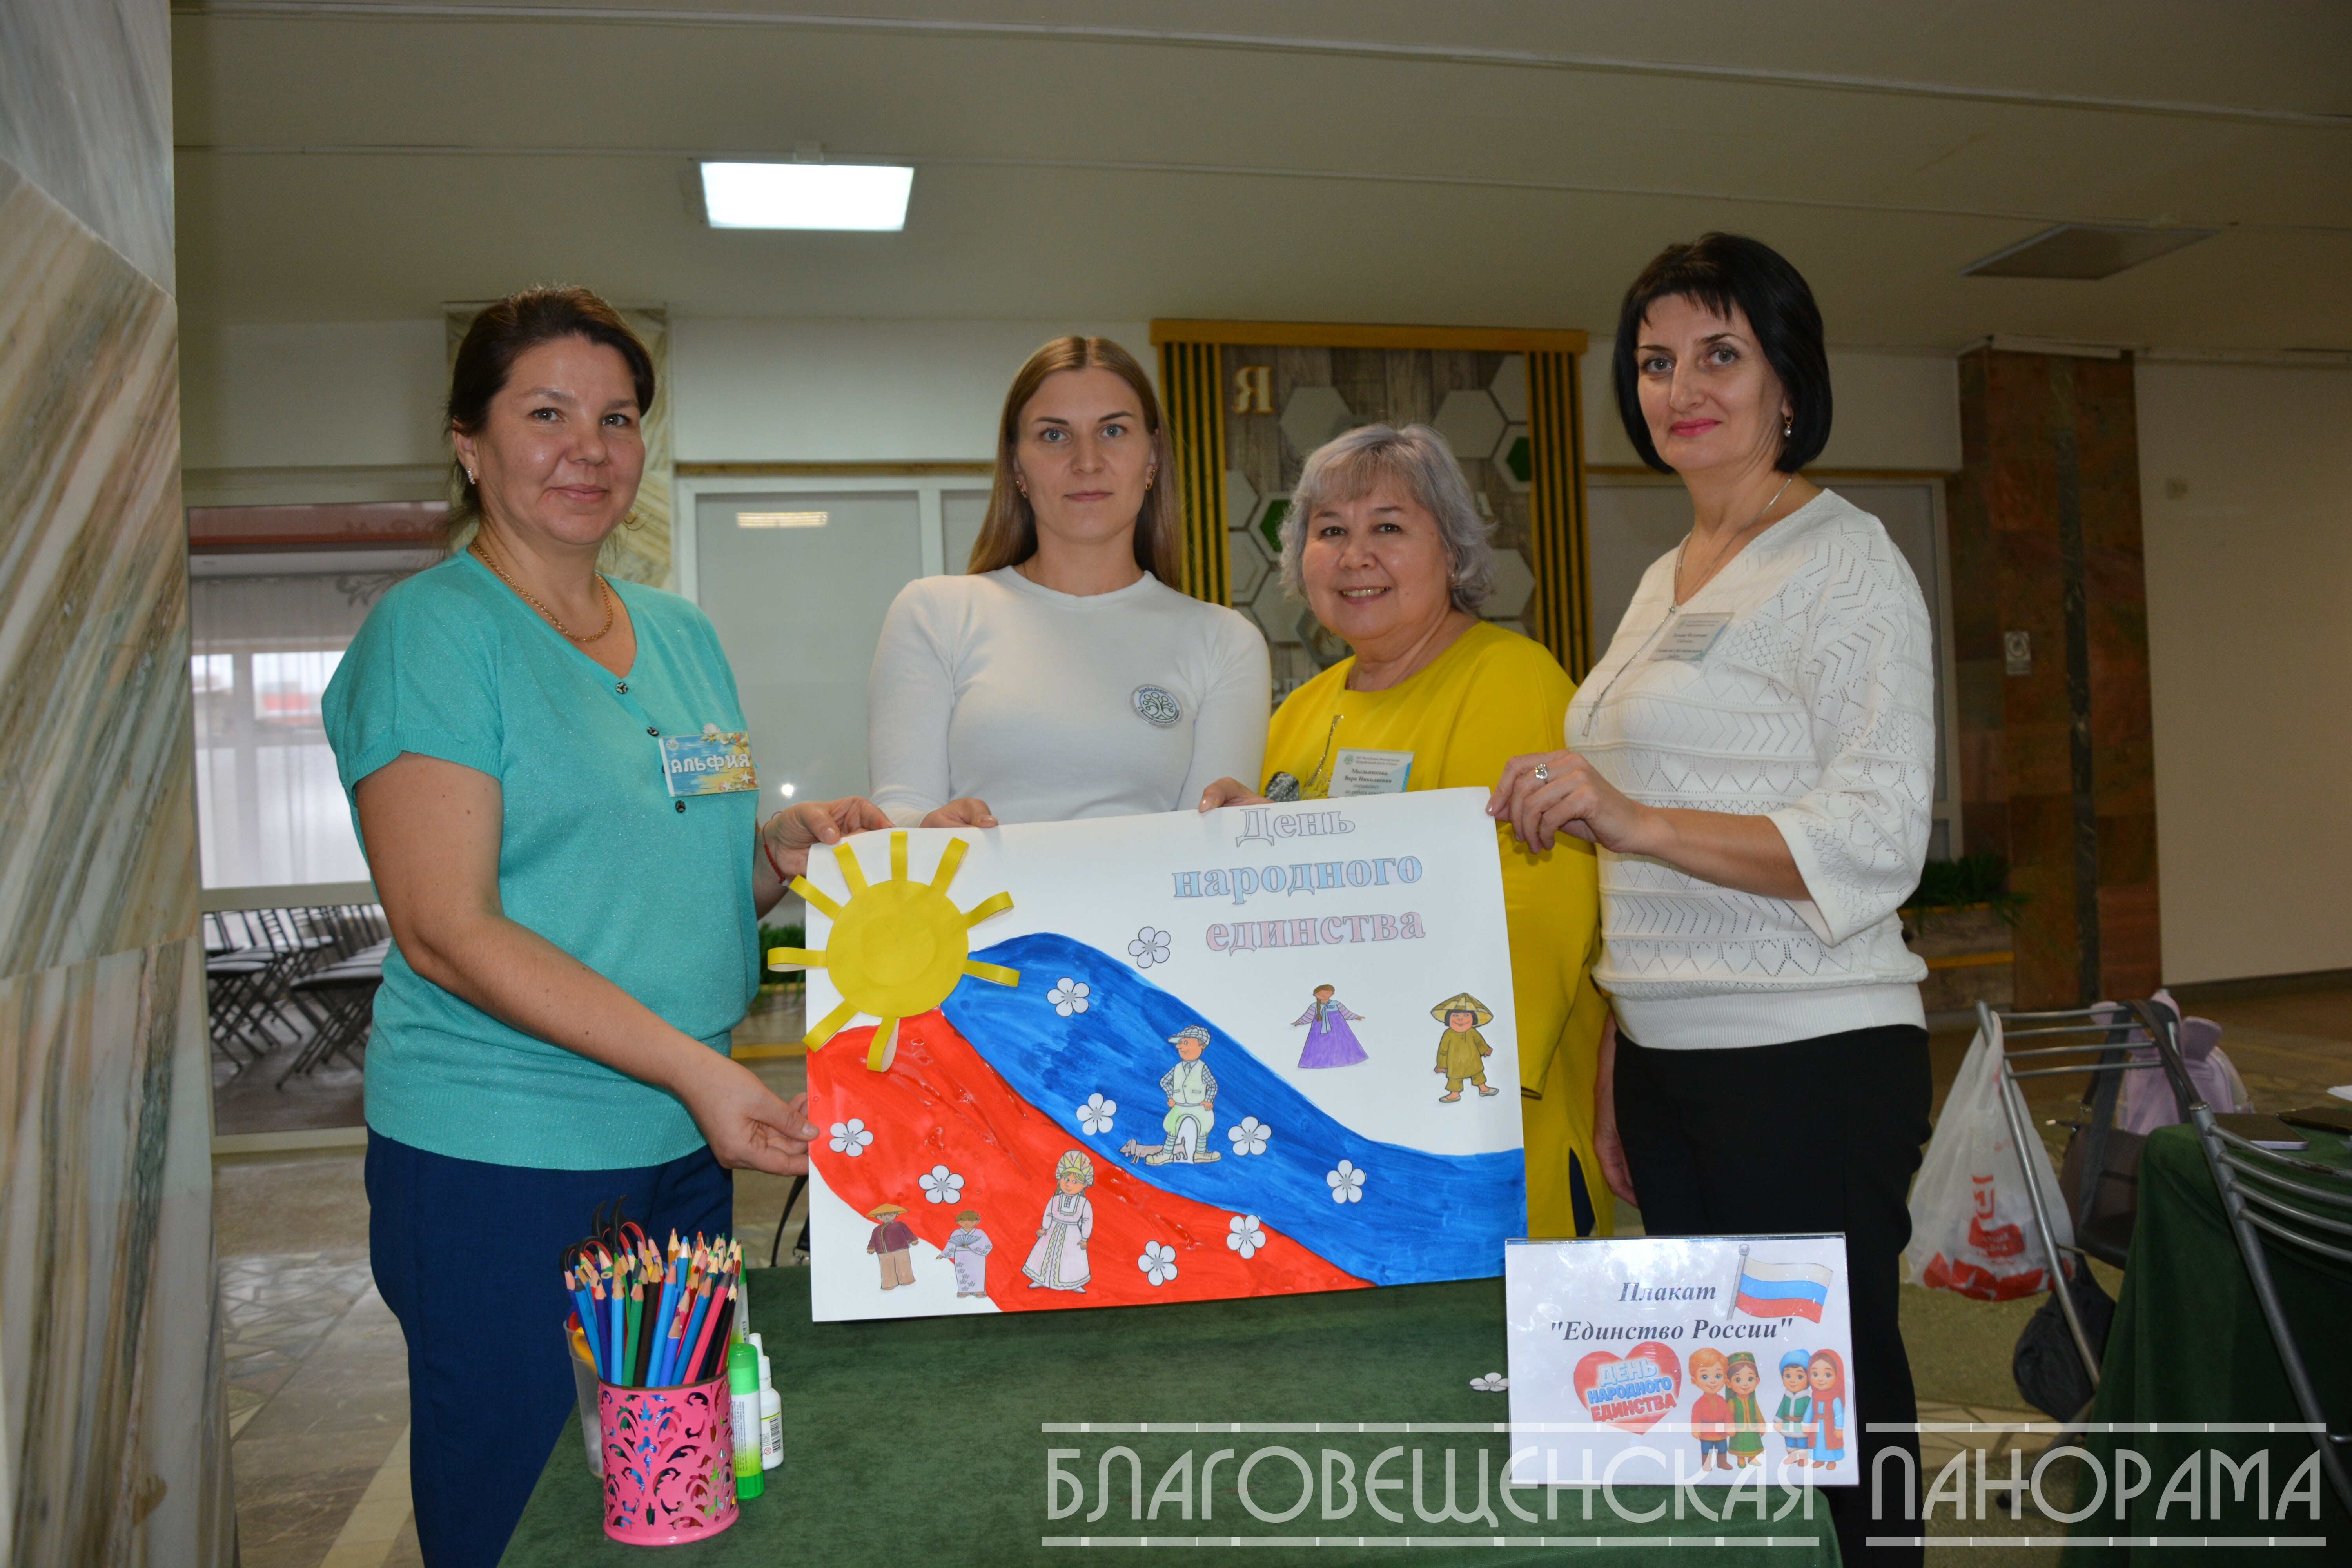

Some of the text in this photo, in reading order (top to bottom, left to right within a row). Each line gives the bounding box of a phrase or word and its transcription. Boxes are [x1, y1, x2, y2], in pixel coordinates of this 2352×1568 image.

[1231, 366, 1275, 414] Я
[671, 753, 750, 773] АЛЬФИЯ
[1236, 808, 1356, 847] День
[1172, 856, 1423, 904] народного
[1206, 911, 1426, 955] единства
[1618, 1282, 1716, 1302] Плакат
[1551, 1317, 1793, 1341] "Единство России"
[1599, 1359, 1657, 1387] ДЕНЬ
[1588, 1377, 1672, 1404] НАРОДНОГО
[1590, 1393, 1677, 1422] ЕДИНСТВА
